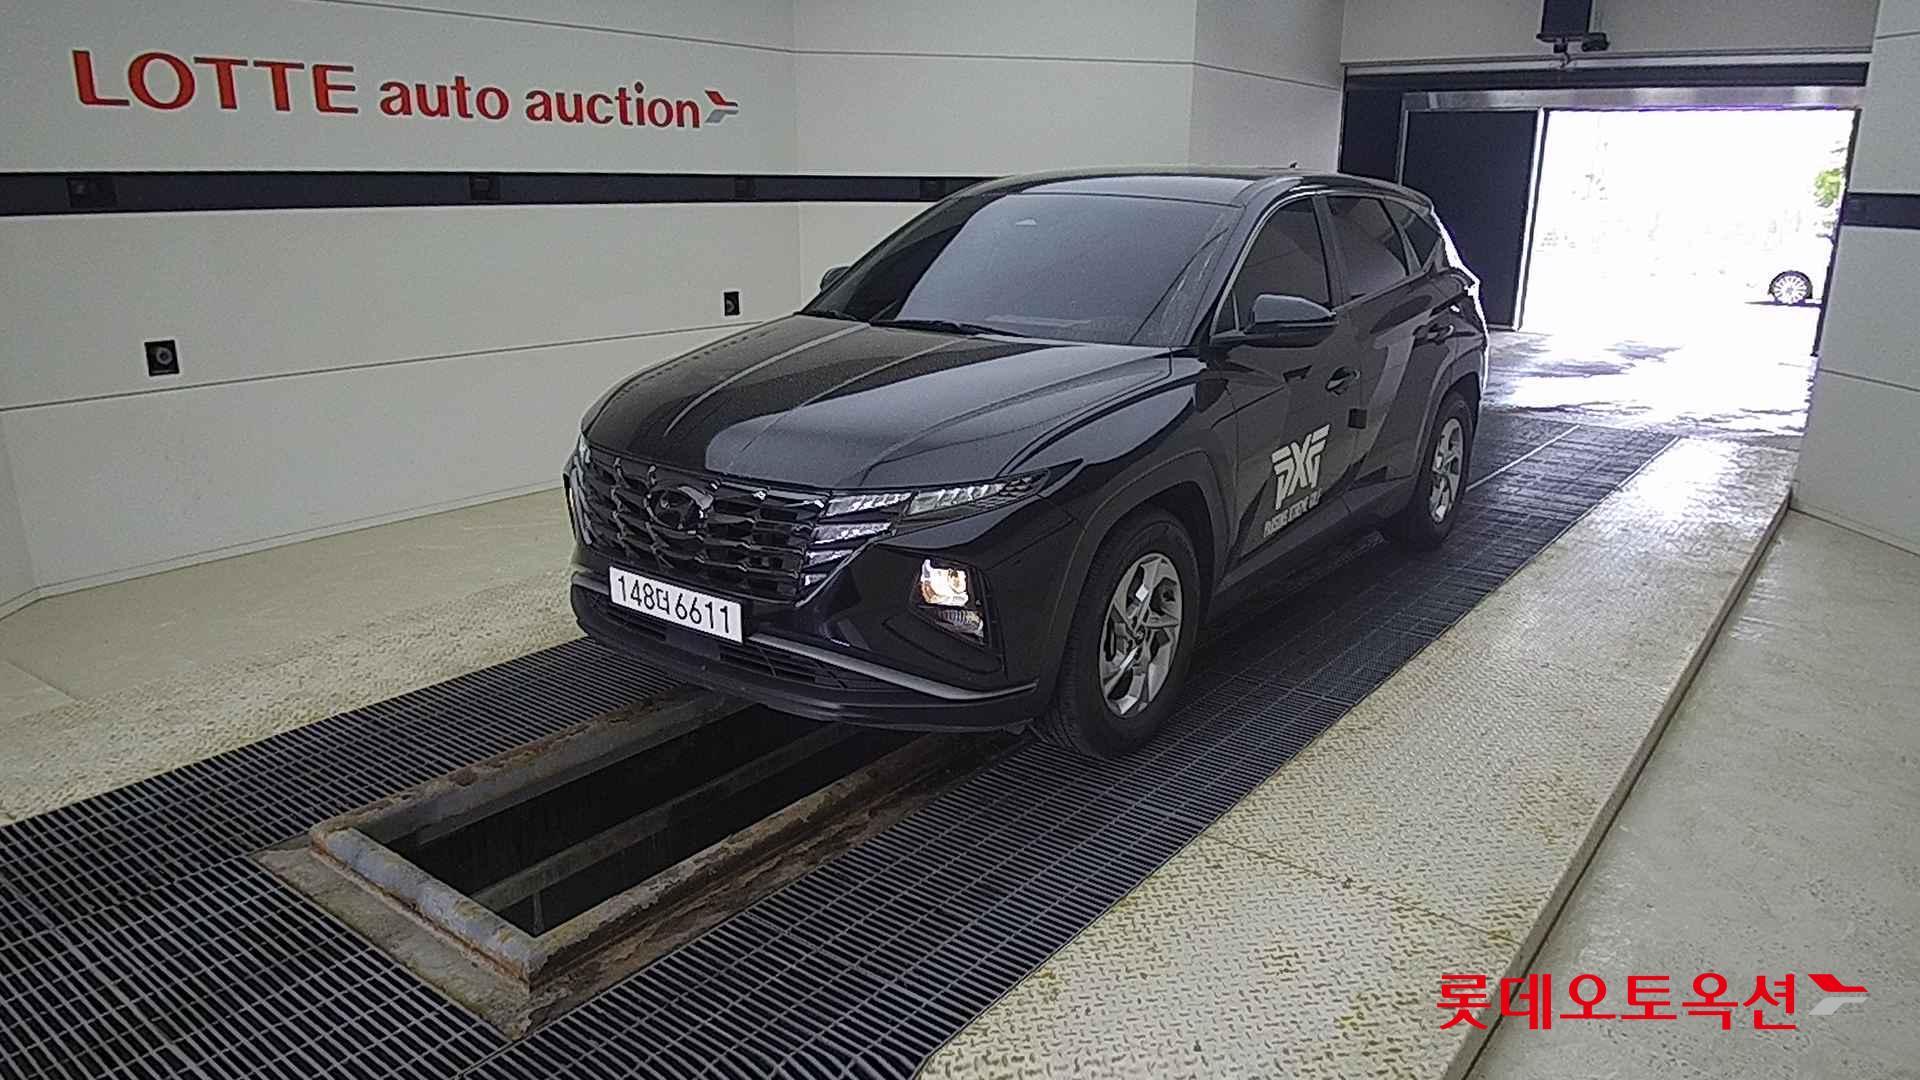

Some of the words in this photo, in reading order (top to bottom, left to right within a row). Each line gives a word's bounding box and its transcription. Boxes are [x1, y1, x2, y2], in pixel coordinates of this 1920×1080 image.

[72, 50, 359, 115] LOTTE
[379, 76, 509, 121] auto
[525, 81, 700, 128] auction
